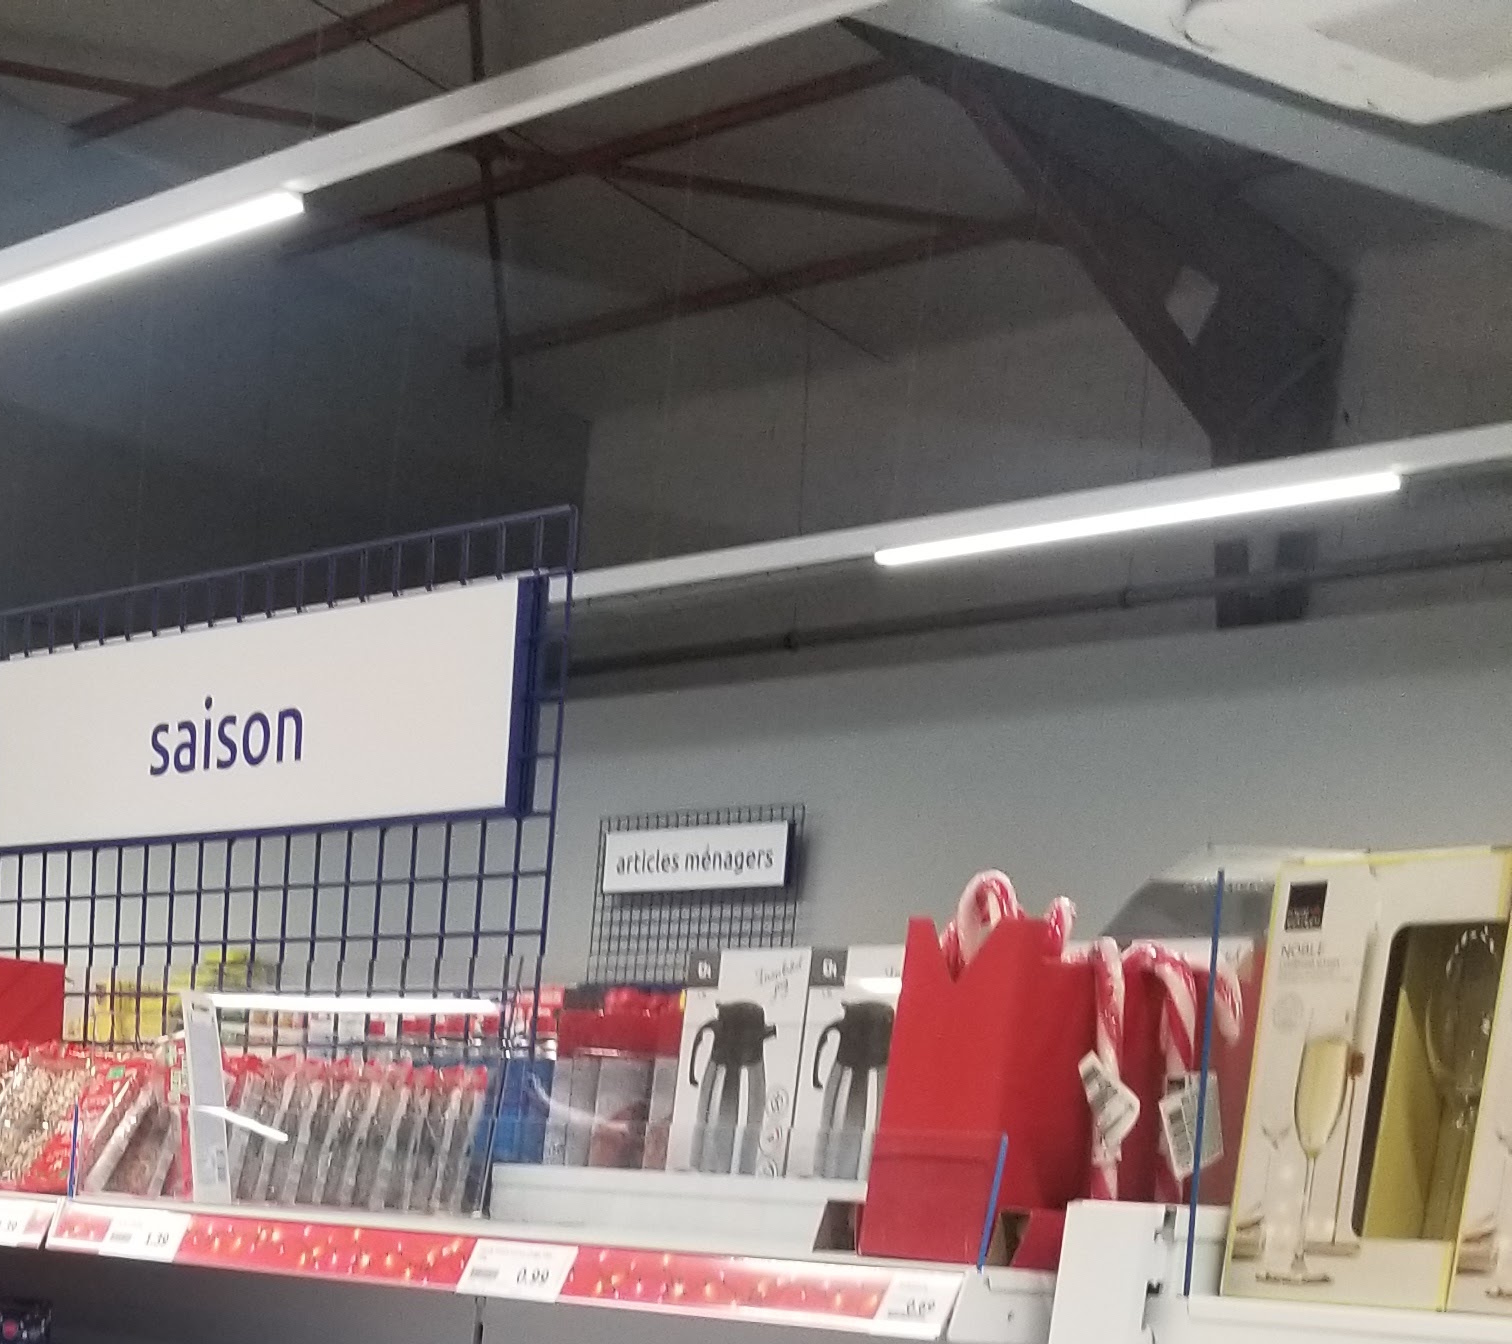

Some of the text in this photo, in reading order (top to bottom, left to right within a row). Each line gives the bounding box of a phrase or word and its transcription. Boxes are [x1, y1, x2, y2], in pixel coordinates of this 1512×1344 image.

[148, 695, 303, 776] saison
[615, 842, 774, 876] articles ménagers
